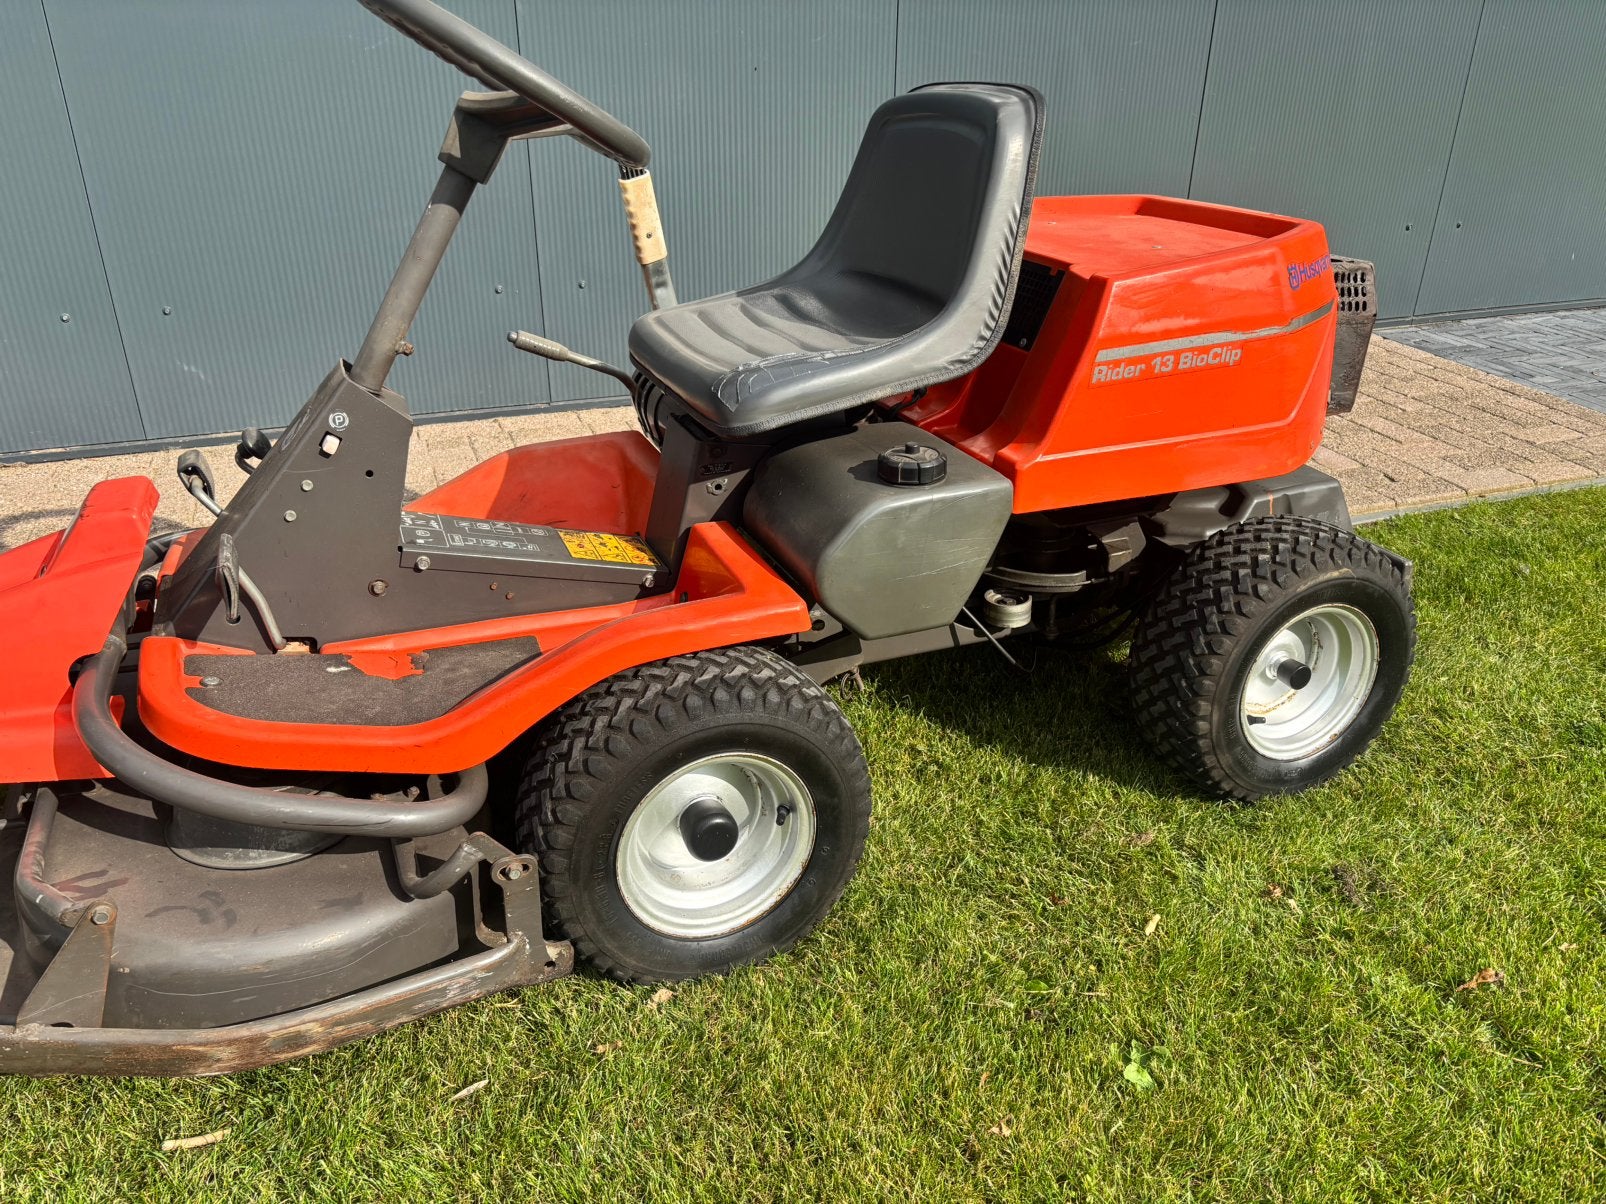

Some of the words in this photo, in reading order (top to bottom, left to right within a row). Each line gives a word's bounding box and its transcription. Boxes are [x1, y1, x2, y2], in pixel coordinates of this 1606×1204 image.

[1092, 362, 1146, 384] Rider
[1151, 354, 1175, 374] 13
[1178, 345, 1242, 370] BioClip
